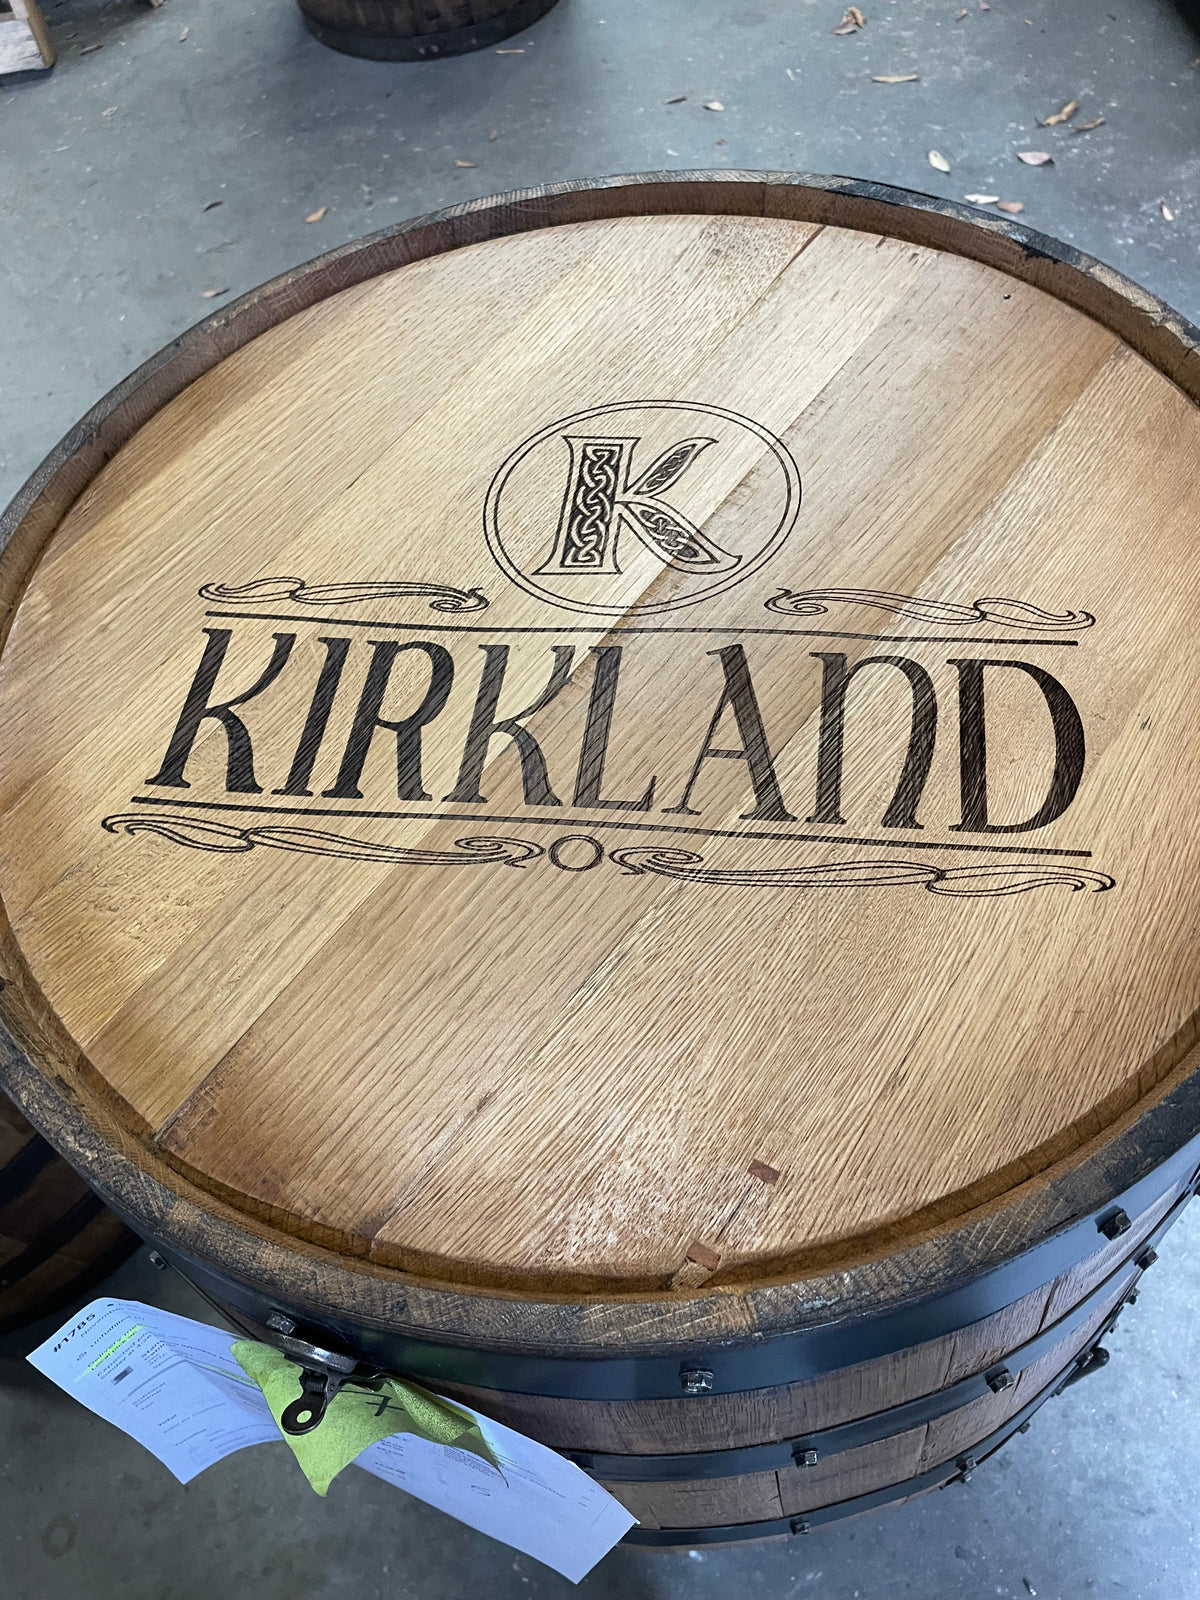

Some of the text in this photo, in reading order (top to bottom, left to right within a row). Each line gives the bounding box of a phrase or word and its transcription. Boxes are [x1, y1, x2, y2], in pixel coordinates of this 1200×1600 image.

[531, 434, 743, 575] K
[144, 627, 1087, 834] KIRKLAND
[53, 1312, 96, 1353] #1785
